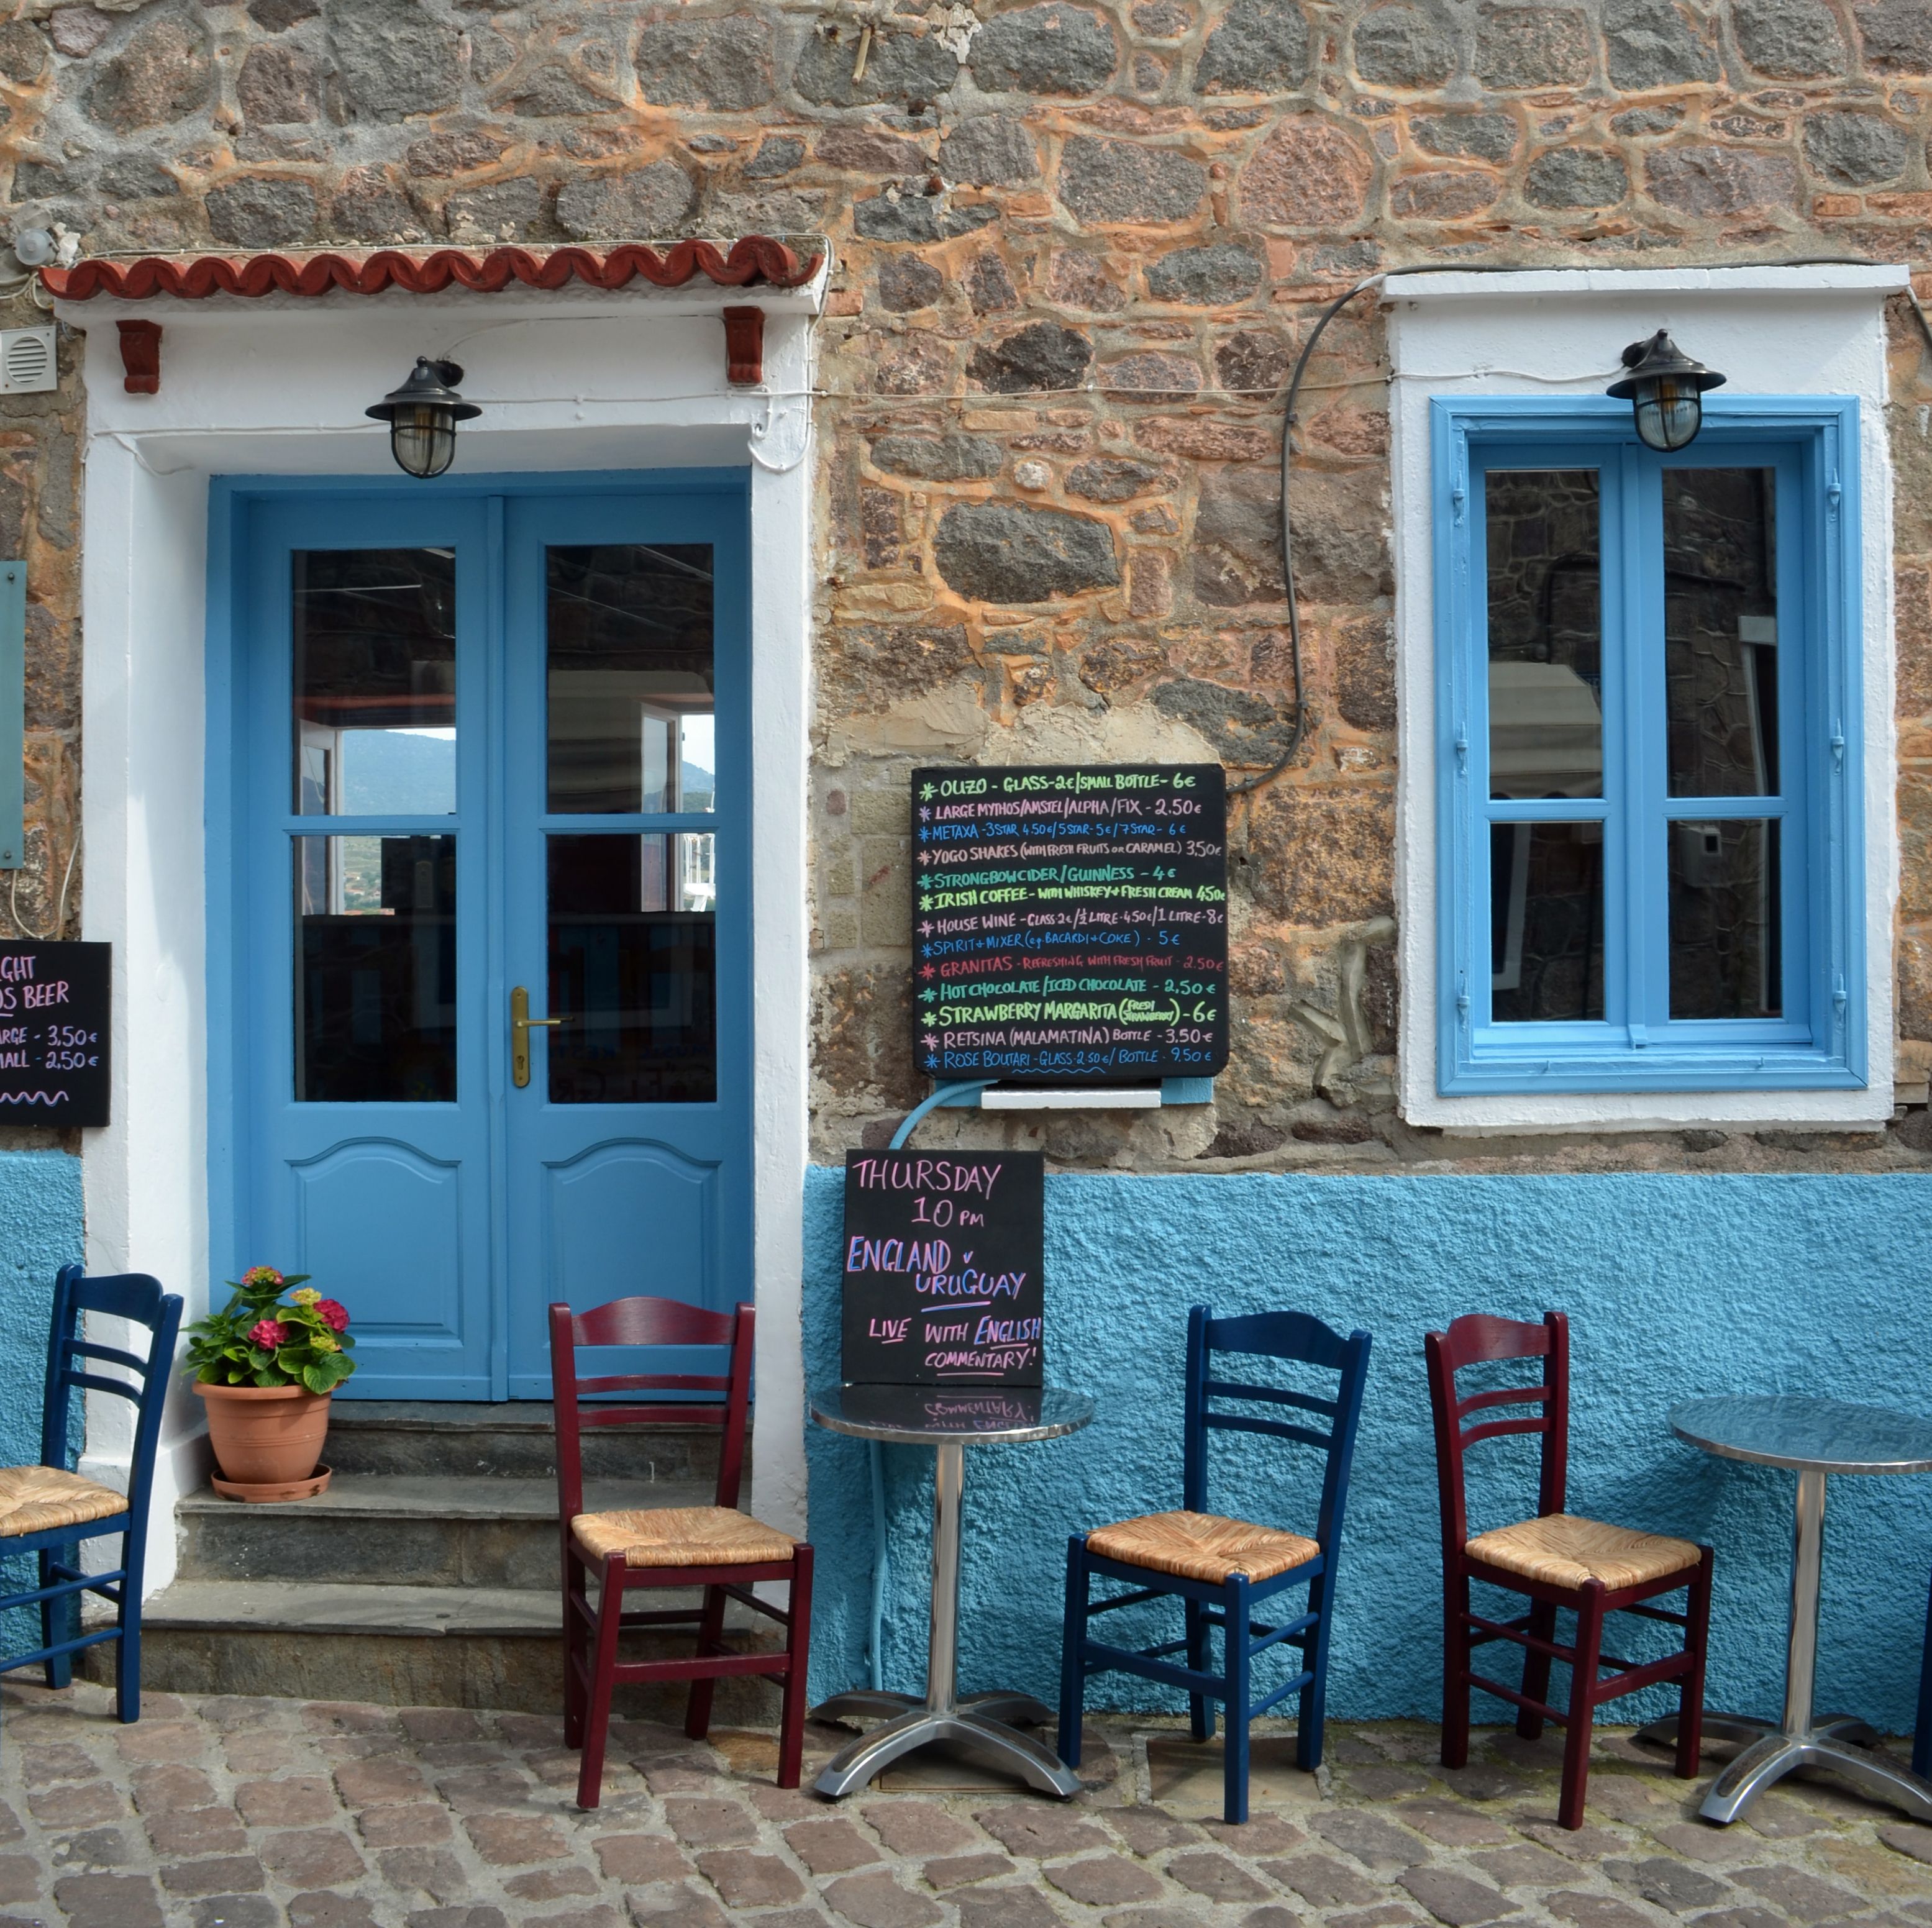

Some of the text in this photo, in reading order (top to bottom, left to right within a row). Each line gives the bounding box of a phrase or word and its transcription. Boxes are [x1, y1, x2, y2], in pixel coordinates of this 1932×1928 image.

[940, 778, 987, 797] OUZO
[935, 803, 975, 820] LARGE
[932, 824, 980, 841] METAXA
[932, 848, 968, 866] YOGO
[970, 844, 1019, 860] SHAKES
[1047, 844, 1074, 857] FRESH
[1076, 843, 1110, 855] FRUITS
[934, 889, 978, 909] IRISH
[1037, 888, 1063, 899] WITH
[1121, 885, 1156, 899] FRESH
[1157, 886, 1193, 899] CREAM
[937, 916, 978, 935] HOUSE
[982, 912, 1016, 929] WINE
[932, 938, 975, 956] SPIRIT
[986, 933, 1025, 948] MIXER
[0, 955, 36, 983] GHT
[941, 957, 1013, 978] GRANITAS
[1088, 955, 1111, 966] WITH
[1113, 955, 1144, 972] FRESH
[1146, 955, 1173, 966] FRUIT
[22, 980, 70, 1009] BEER
[941, 983, 967, 1001] HOT
[968, 980, 1041, 998] CHOCOLATE
[1078, 978, 1147, 992] CHOCOLATE
[939, 1000, 1118, 1027] STRAWBERRY MARGARITA
[0, 1027, 28, 1045] RGE
[944, 1031, 1006, 1049] RETSINA
[1113, 1029, 1152, 1042] BOTTLE
[0, 1050, 30, 1069] ALL
[944, 1051, 980, 1068] ROSE
[983, 1050, 1030, 1067] BOUTARI
[1119, 1049, 1159, 1064] BOTTLE
[852, 1159, 1002, 1199] THURSDAY
[911, 1196, 985, 1227] 10 PM
[847, 1236, 951, 1274] ENGLAND
[916, 1269, 1026, 1299] URUGUAY
[870, 1316, 1041, 1345] LIVE WITH ENGLISH
[924, 1347, 1037, 1370] COMMENTARY!
